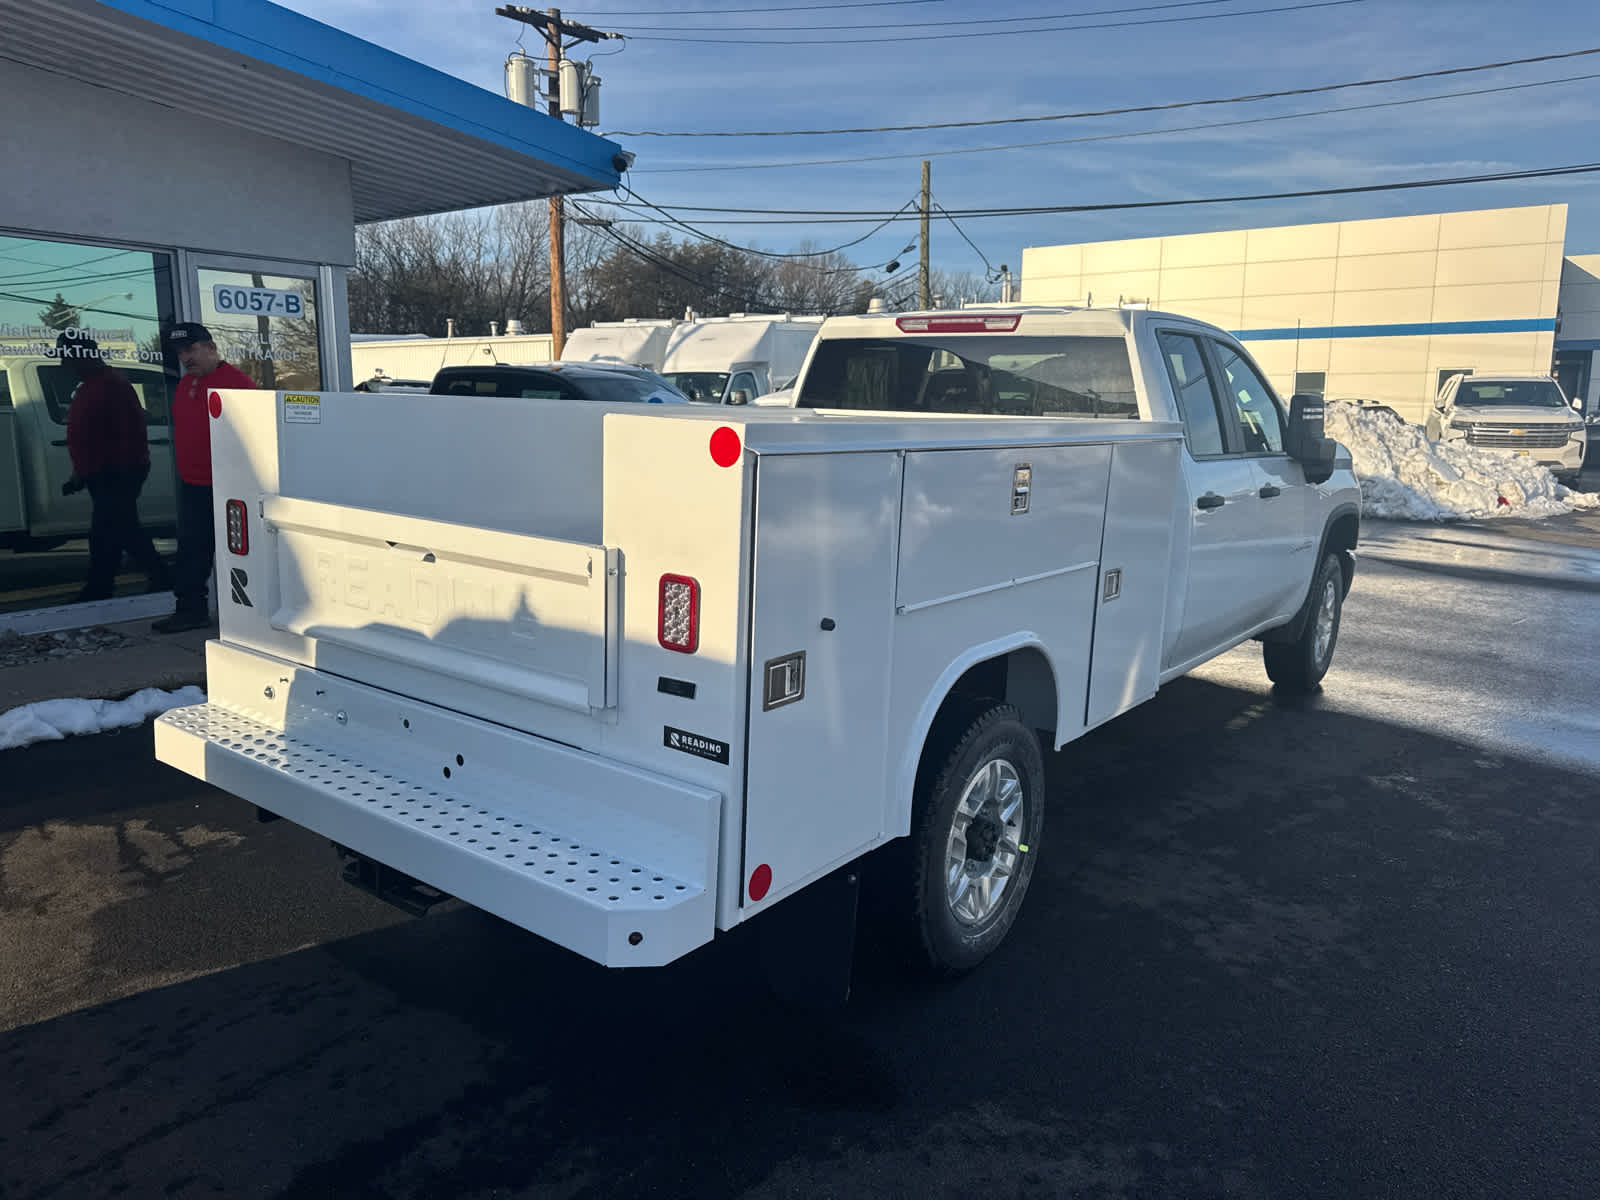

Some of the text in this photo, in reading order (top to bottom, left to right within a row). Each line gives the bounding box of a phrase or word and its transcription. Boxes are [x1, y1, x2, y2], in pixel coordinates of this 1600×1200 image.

[218, 288, 301, 314] 6057-B
[64, 326, 115, 342] Online
[291, 394, 320, 404] CAUTION
[681, 735, 722, 753] READING
